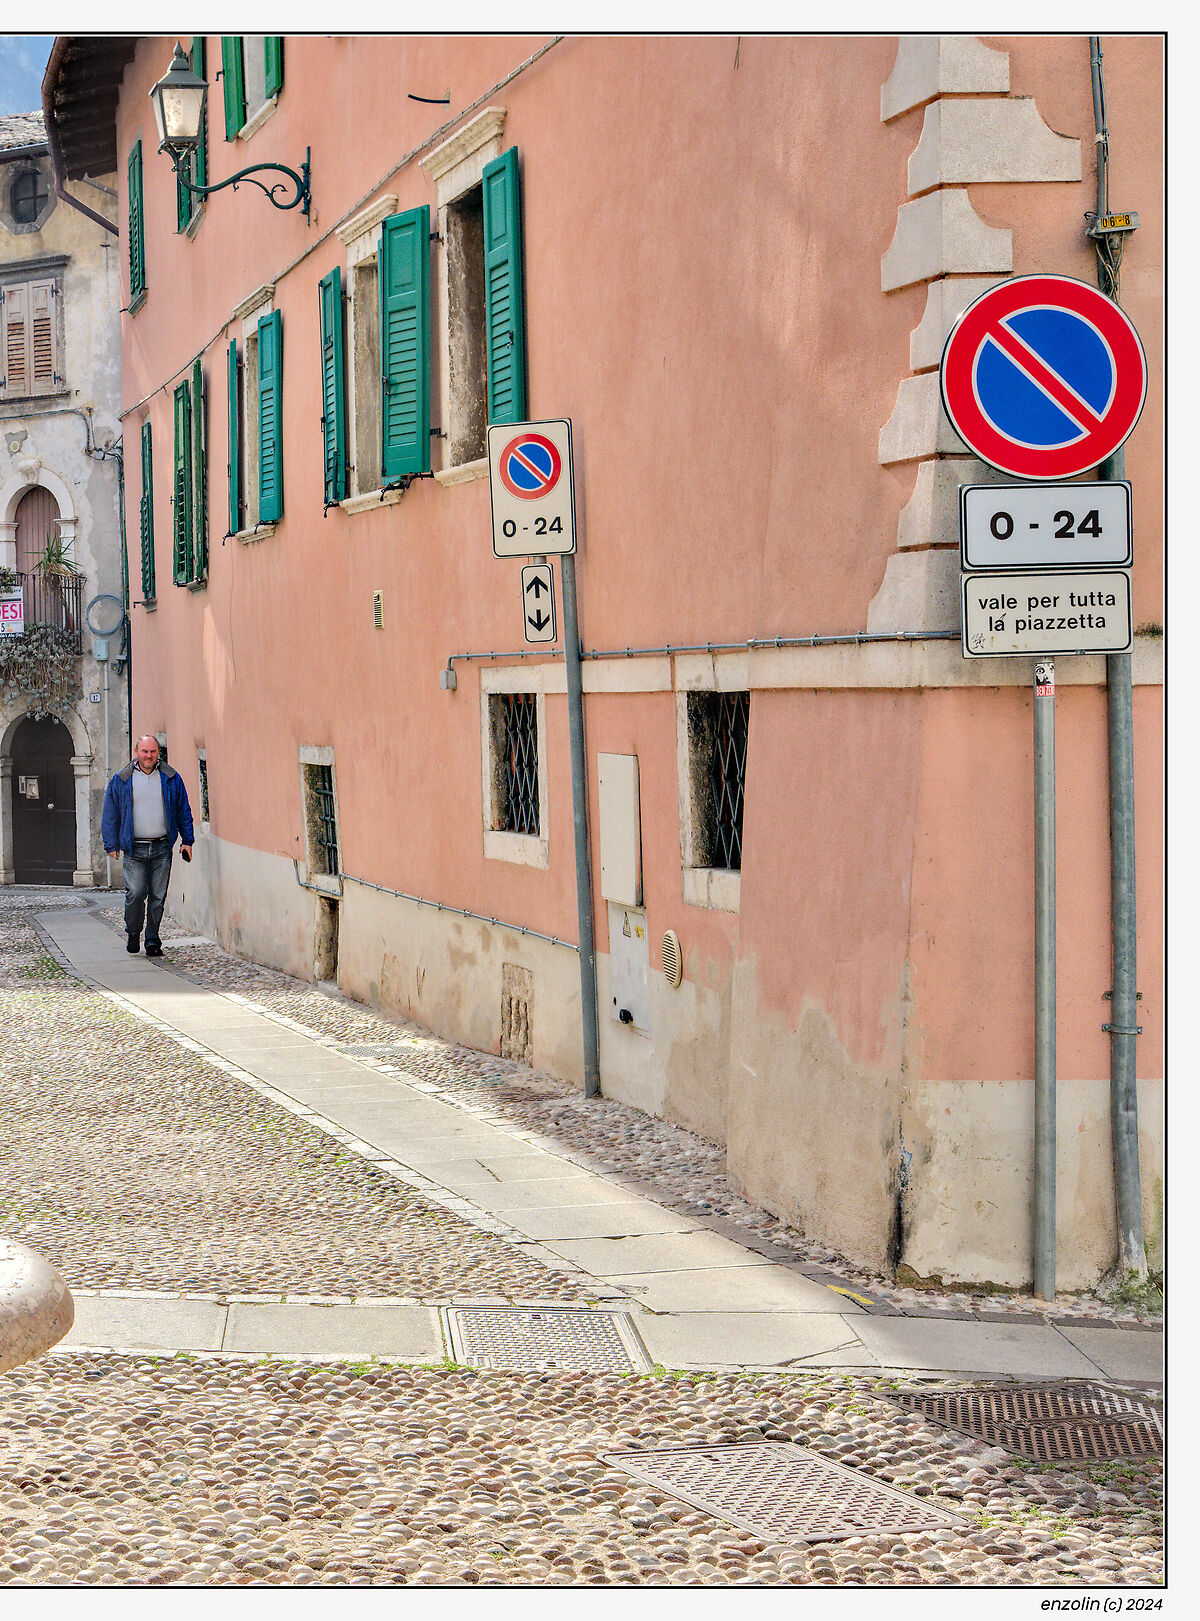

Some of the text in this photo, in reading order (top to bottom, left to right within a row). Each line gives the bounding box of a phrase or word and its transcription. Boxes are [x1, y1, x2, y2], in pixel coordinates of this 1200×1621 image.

[502, 519, 517, 538] 0
[534, 516, 564, 535] 24
[989, 511, 1015, 541] 0
[1053, 509, 1103, 539] 24
[978, 591, 1116, 611] vale per tutta
[1015, 613, 1106, 634] piazzetta
